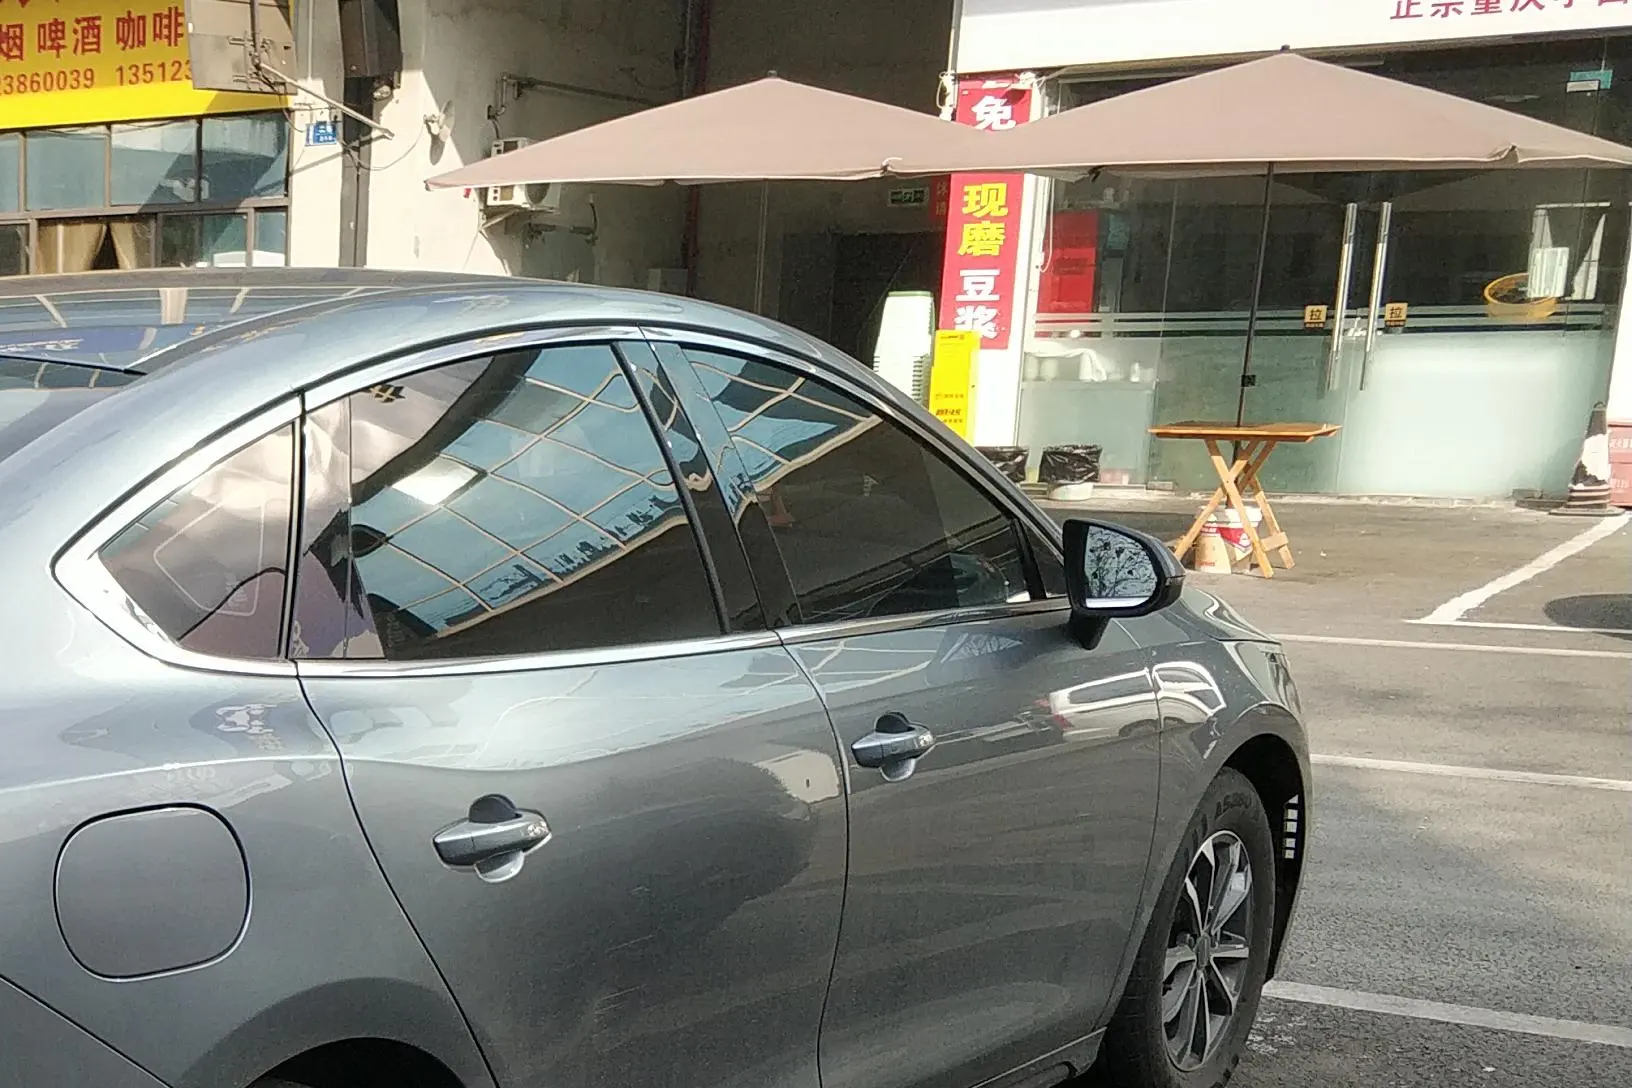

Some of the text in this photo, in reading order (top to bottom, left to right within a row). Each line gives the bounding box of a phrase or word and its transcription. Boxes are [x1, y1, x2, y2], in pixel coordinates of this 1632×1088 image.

[37, 15, 103, 59] 啤酒
[115, 6, 185, 51] 咖啡
[953, 182, 1009, 340] 现磨 豆浆
